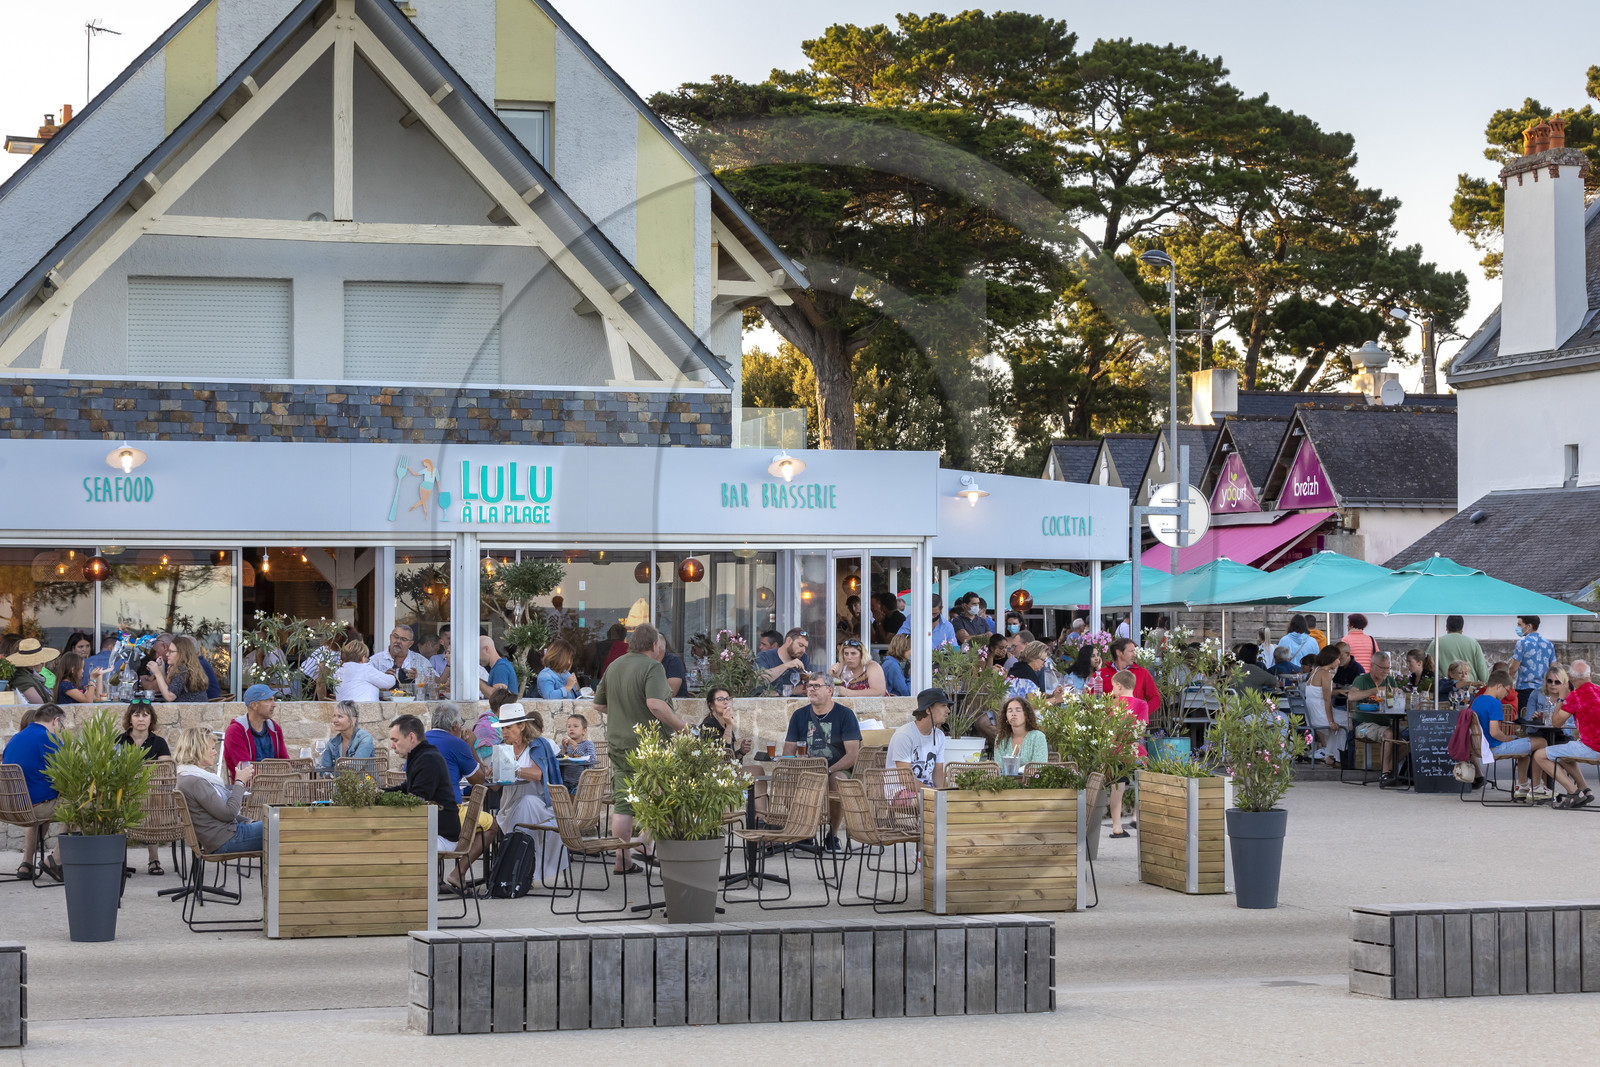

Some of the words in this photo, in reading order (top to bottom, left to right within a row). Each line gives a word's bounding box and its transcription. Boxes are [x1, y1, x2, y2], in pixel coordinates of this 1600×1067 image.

[83, 476, 154, 503] SEAFOOD
[721, 482, 749, 509] BAR
[762, 482, 837, 509] BRASSERIE
[1294, 475, 1319, 496] breizh
[461, 501, 472, 524] À
[478, 505, 498, 524] LA
[503, 504, 550, 524] PLAGE
[1042, 515, 1092, 537] COCKTAI
